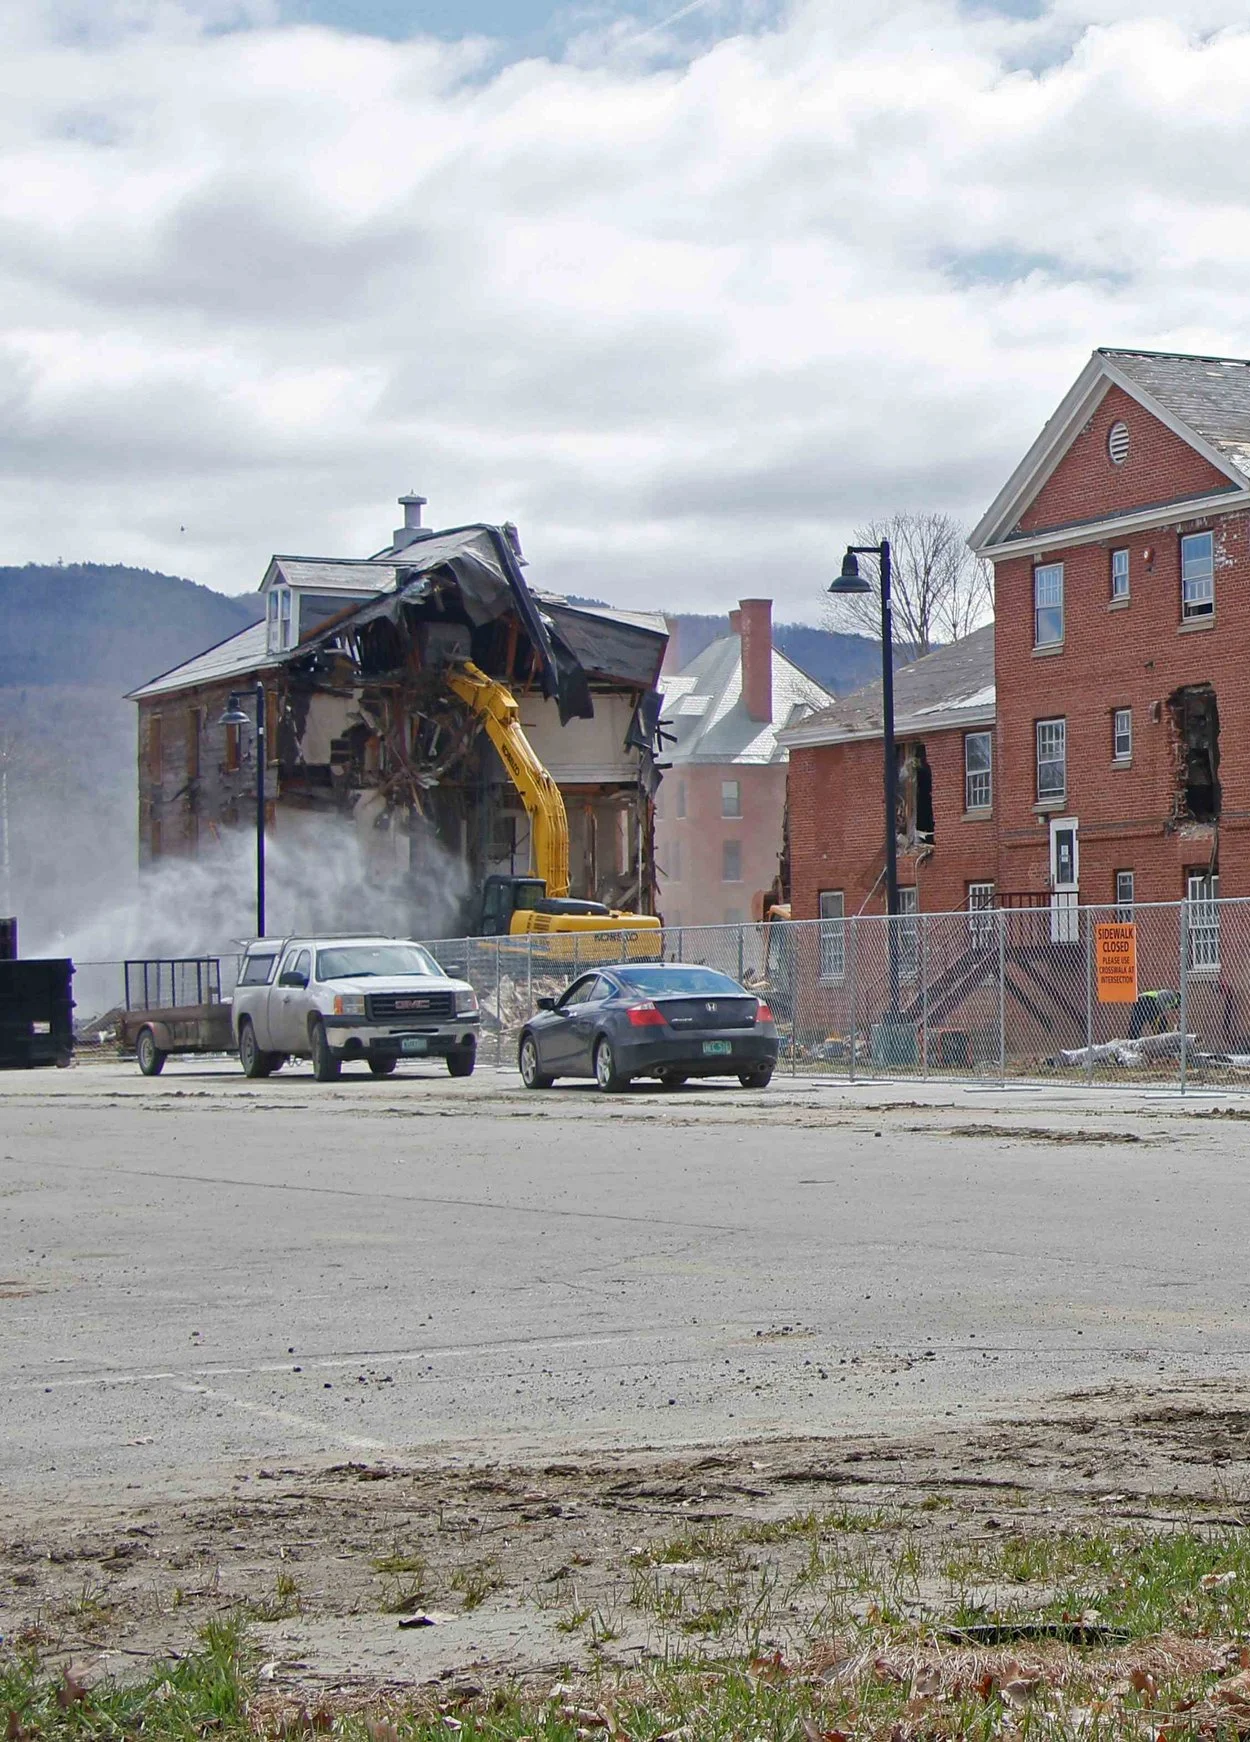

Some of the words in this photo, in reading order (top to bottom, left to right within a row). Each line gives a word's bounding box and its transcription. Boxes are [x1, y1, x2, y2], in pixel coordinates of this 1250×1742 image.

[1098, 928, 1133, 940] SIDEWALK
[1102, 941, 1129, 953] CLOSED
[1102, 956, 1120, 965] PLEASE
[1121, 956, 1130, 965] USE
[1099, 966, 1127, 974] CROSSWALK
[1101, 976, 1133, 984] INTERSECTION
